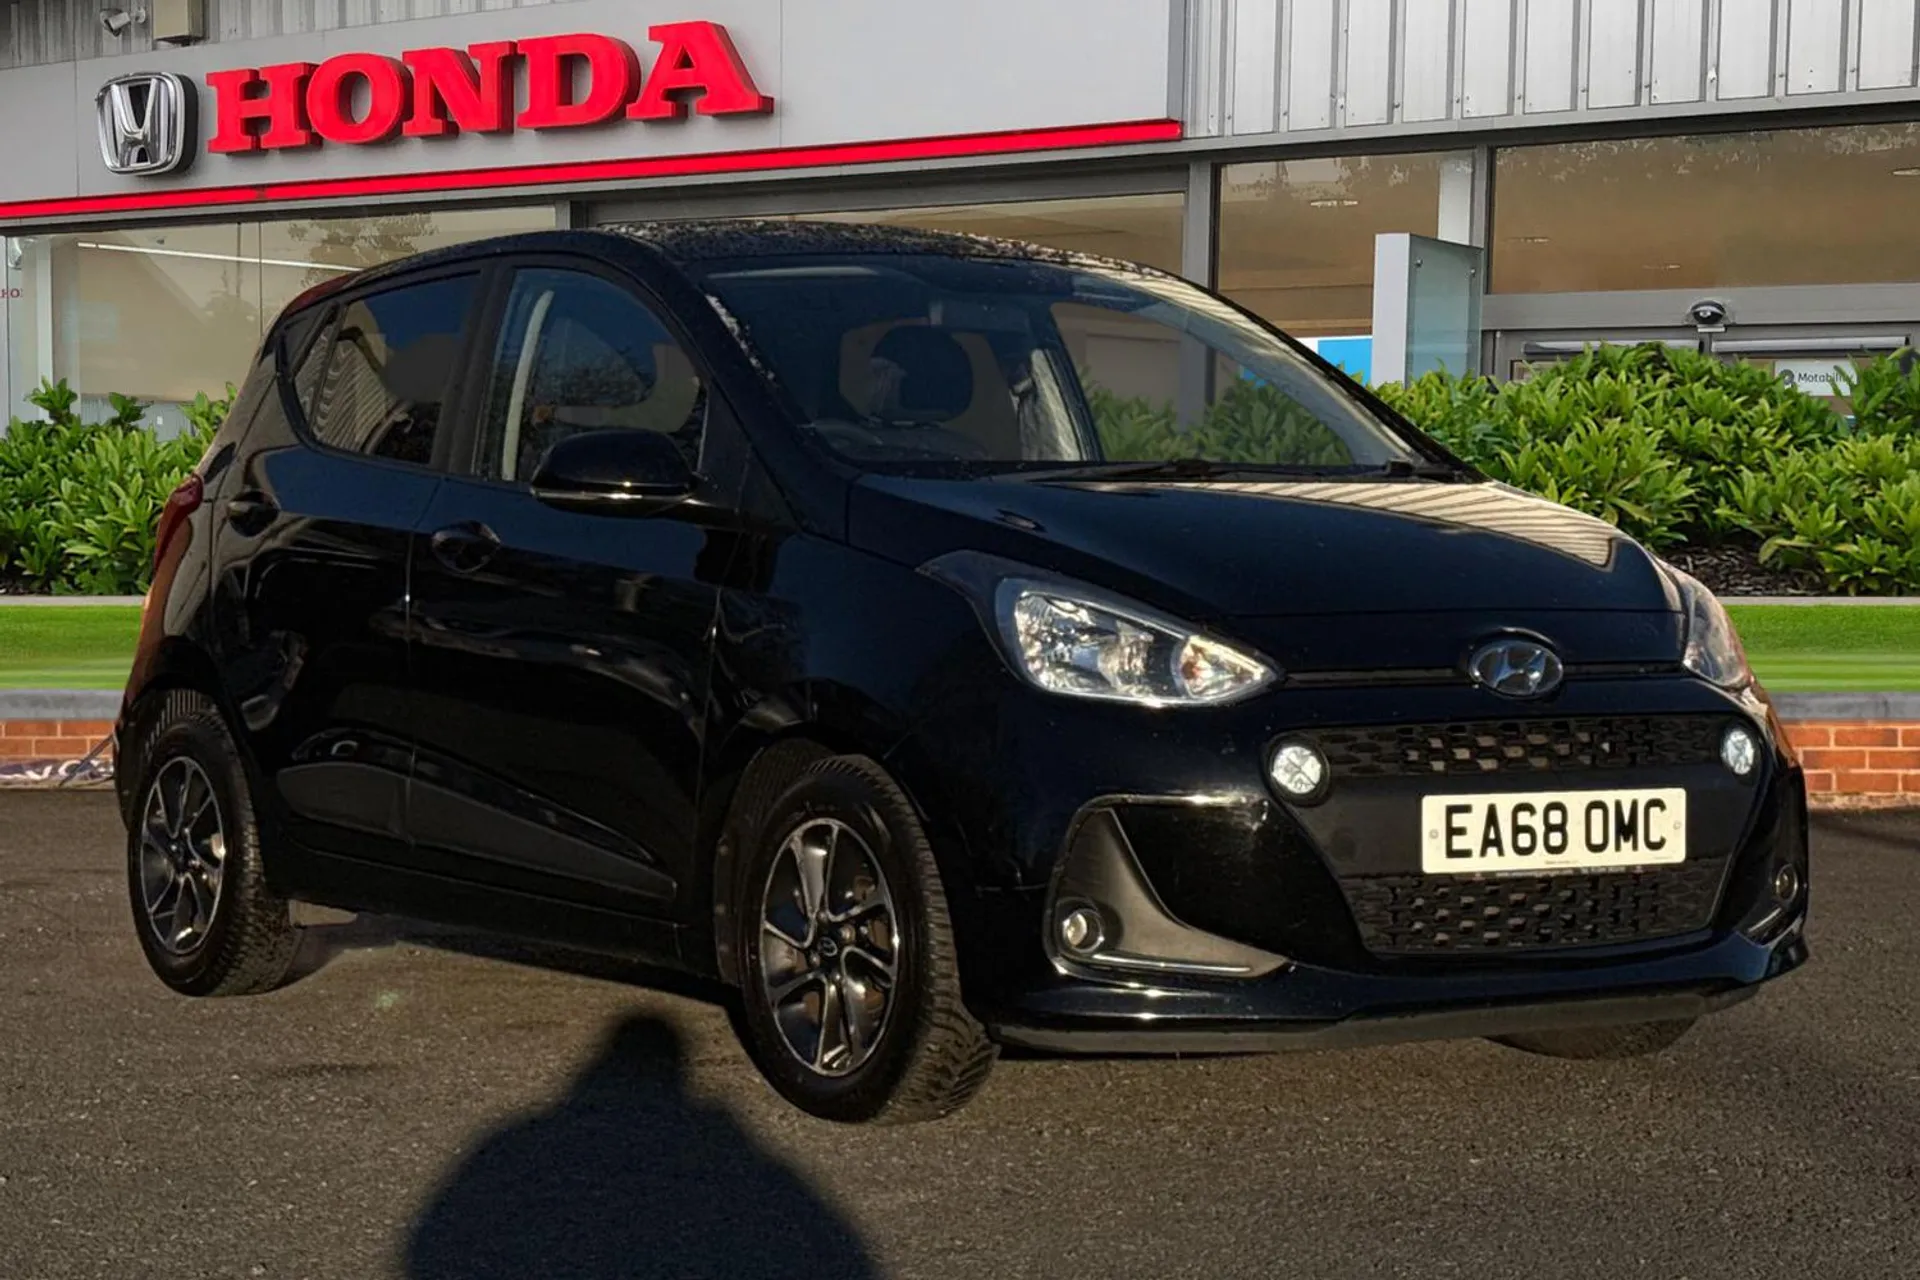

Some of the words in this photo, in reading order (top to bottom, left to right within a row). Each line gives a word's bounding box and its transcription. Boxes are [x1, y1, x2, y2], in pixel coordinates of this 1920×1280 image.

[206, 20, 774, 154] HONDA
[1446, 801, 1567, 858] EA68
[1584, 798, 1666, 854] OMC
